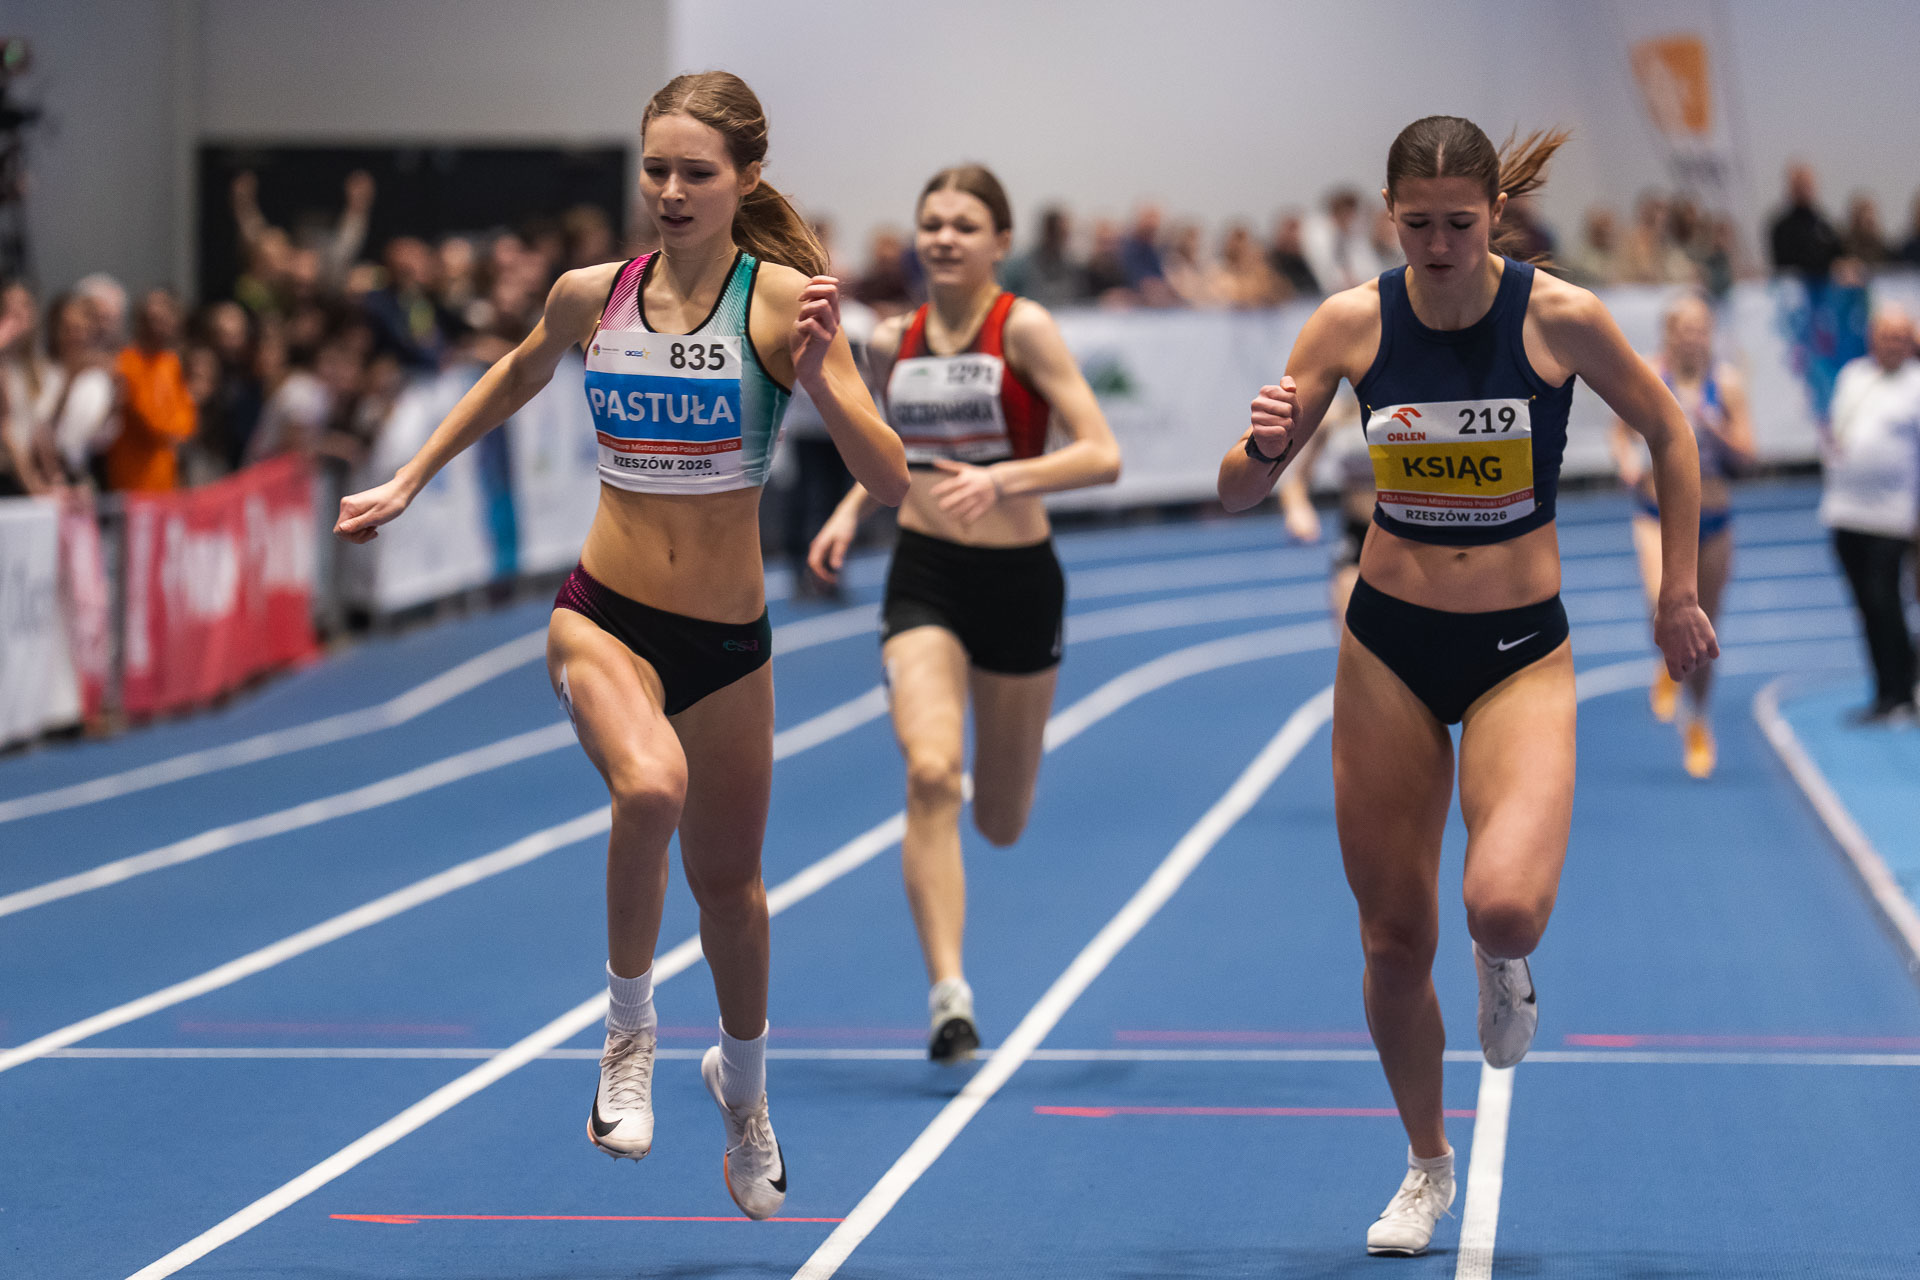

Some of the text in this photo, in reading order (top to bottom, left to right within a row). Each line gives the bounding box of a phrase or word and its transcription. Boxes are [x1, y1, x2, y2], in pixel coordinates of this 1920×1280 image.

[670, 342, 726, 371] 835
[589, 387, 736, 425] PASTUŁA
[1458, 406, 1516, 435] 219
[631, 443, 678, 452] Mistrzostwa
[1387, 431, 1426, 442] ORLEN
[613, 455, 712, 470] RZESZÓW 2026
[1402, 456, 1503, 487] KSIĄG
[1406, 509, 1507, 522] RZESZÓW 2026
